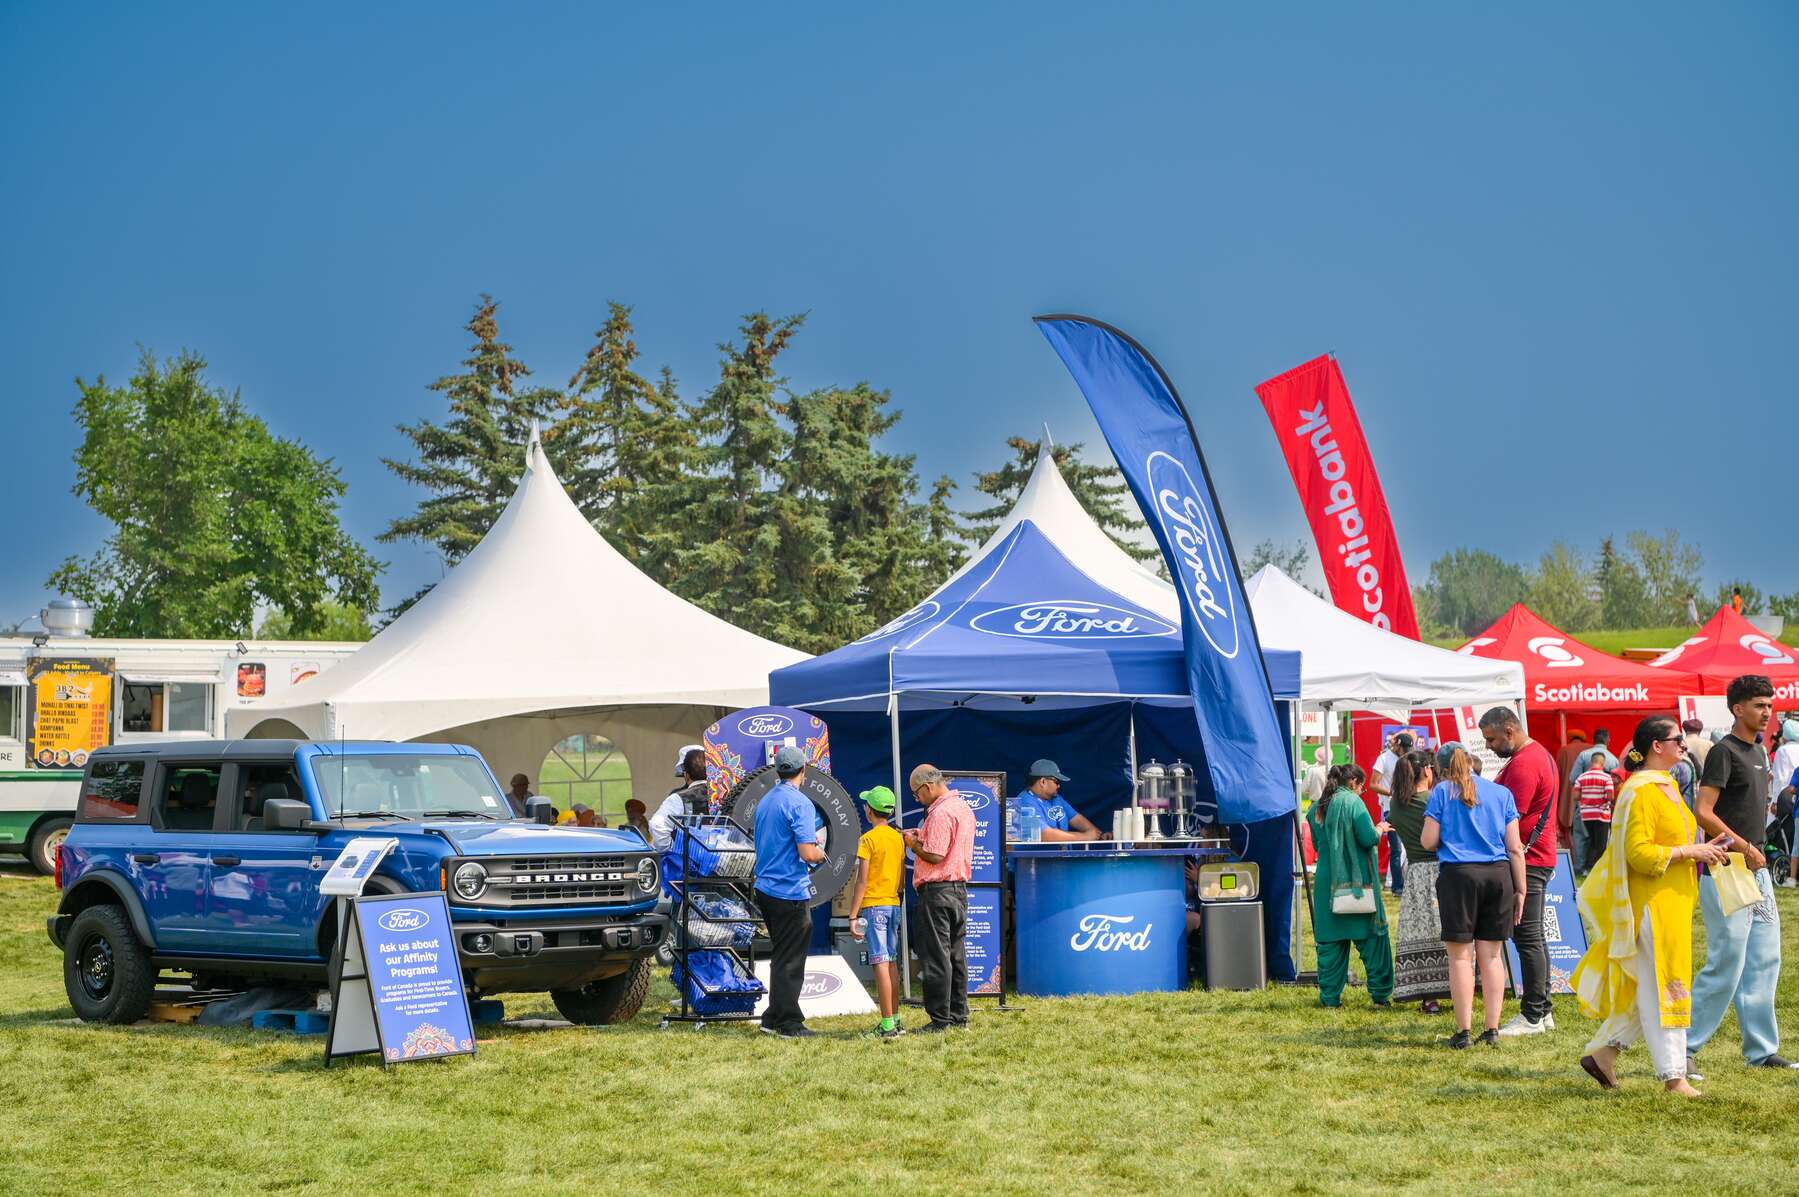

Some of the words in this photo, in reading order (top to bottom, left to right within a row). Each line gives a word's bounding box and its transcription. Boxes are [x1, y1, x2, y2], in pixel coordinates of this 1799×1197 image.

[1159, 487, 1228, 621] Ford
[1013, 604, 1139, 634] Ford
[1535, 683, 1649, 703] Scotiabank
[749, 717, 783, 735] Ford
[1300, 711, 1318, 723] ONE
[809, 780, 832, 799] FOR
[831, 797, 850, 828] PLAY
[516, 873, 622, 883] BRONCO
[1545, 893, 1563, 903] Play
[388, 911, 420, 929] Ford
[1070, 914, 1153, 951] Ford
[380, 942, 397, 953] Ask
[399, 943, 410, 951] us
[412, 939, 440, 950] about
[386, 956, 402, 965] our
[404, 951, 438, 964] Affinity
[391, 964, 439, 978] Programs!
[801, 975, 828, 994] ord
